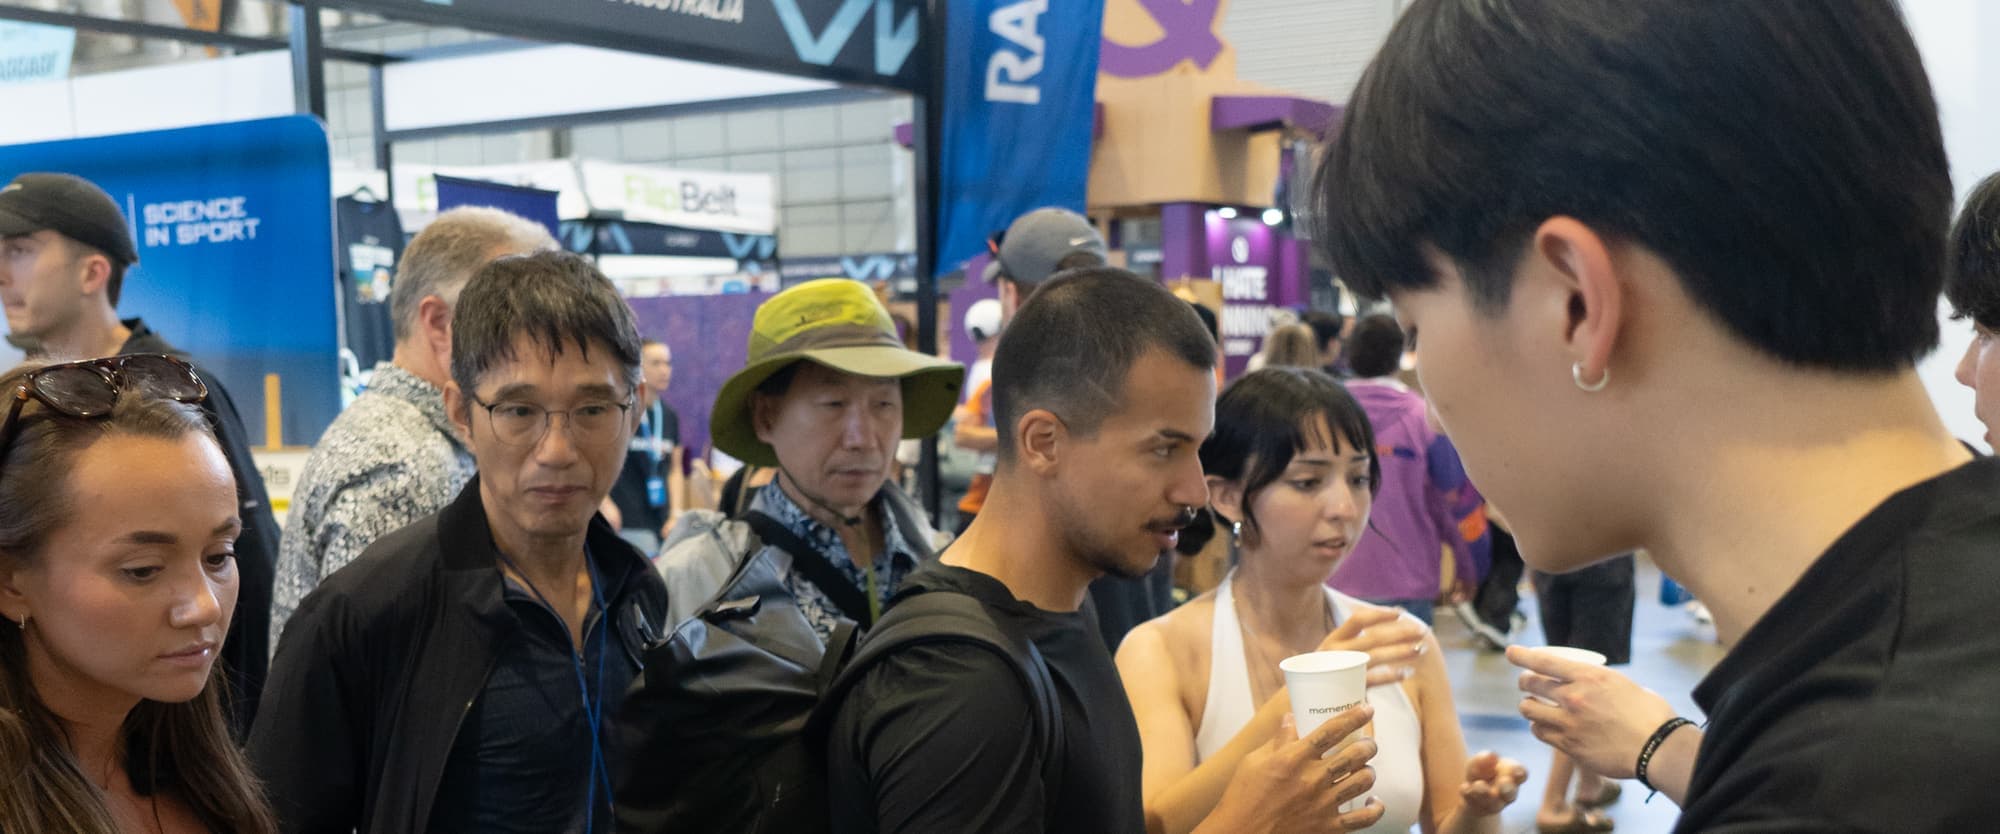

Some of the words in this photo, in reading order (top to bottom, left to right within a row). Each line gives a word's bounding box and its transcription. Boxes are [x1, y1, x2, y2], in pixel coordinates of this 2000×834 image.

[624, 0, 744, 24] STRALIA
[985, 0, 1049, 104] RA
[143, 196, 247, 225] SCIENCE
[144, 226, 170, 247] IN
[177, 218, 260, 245] SPORT
[1222, 266, 1268, 300] HATE
